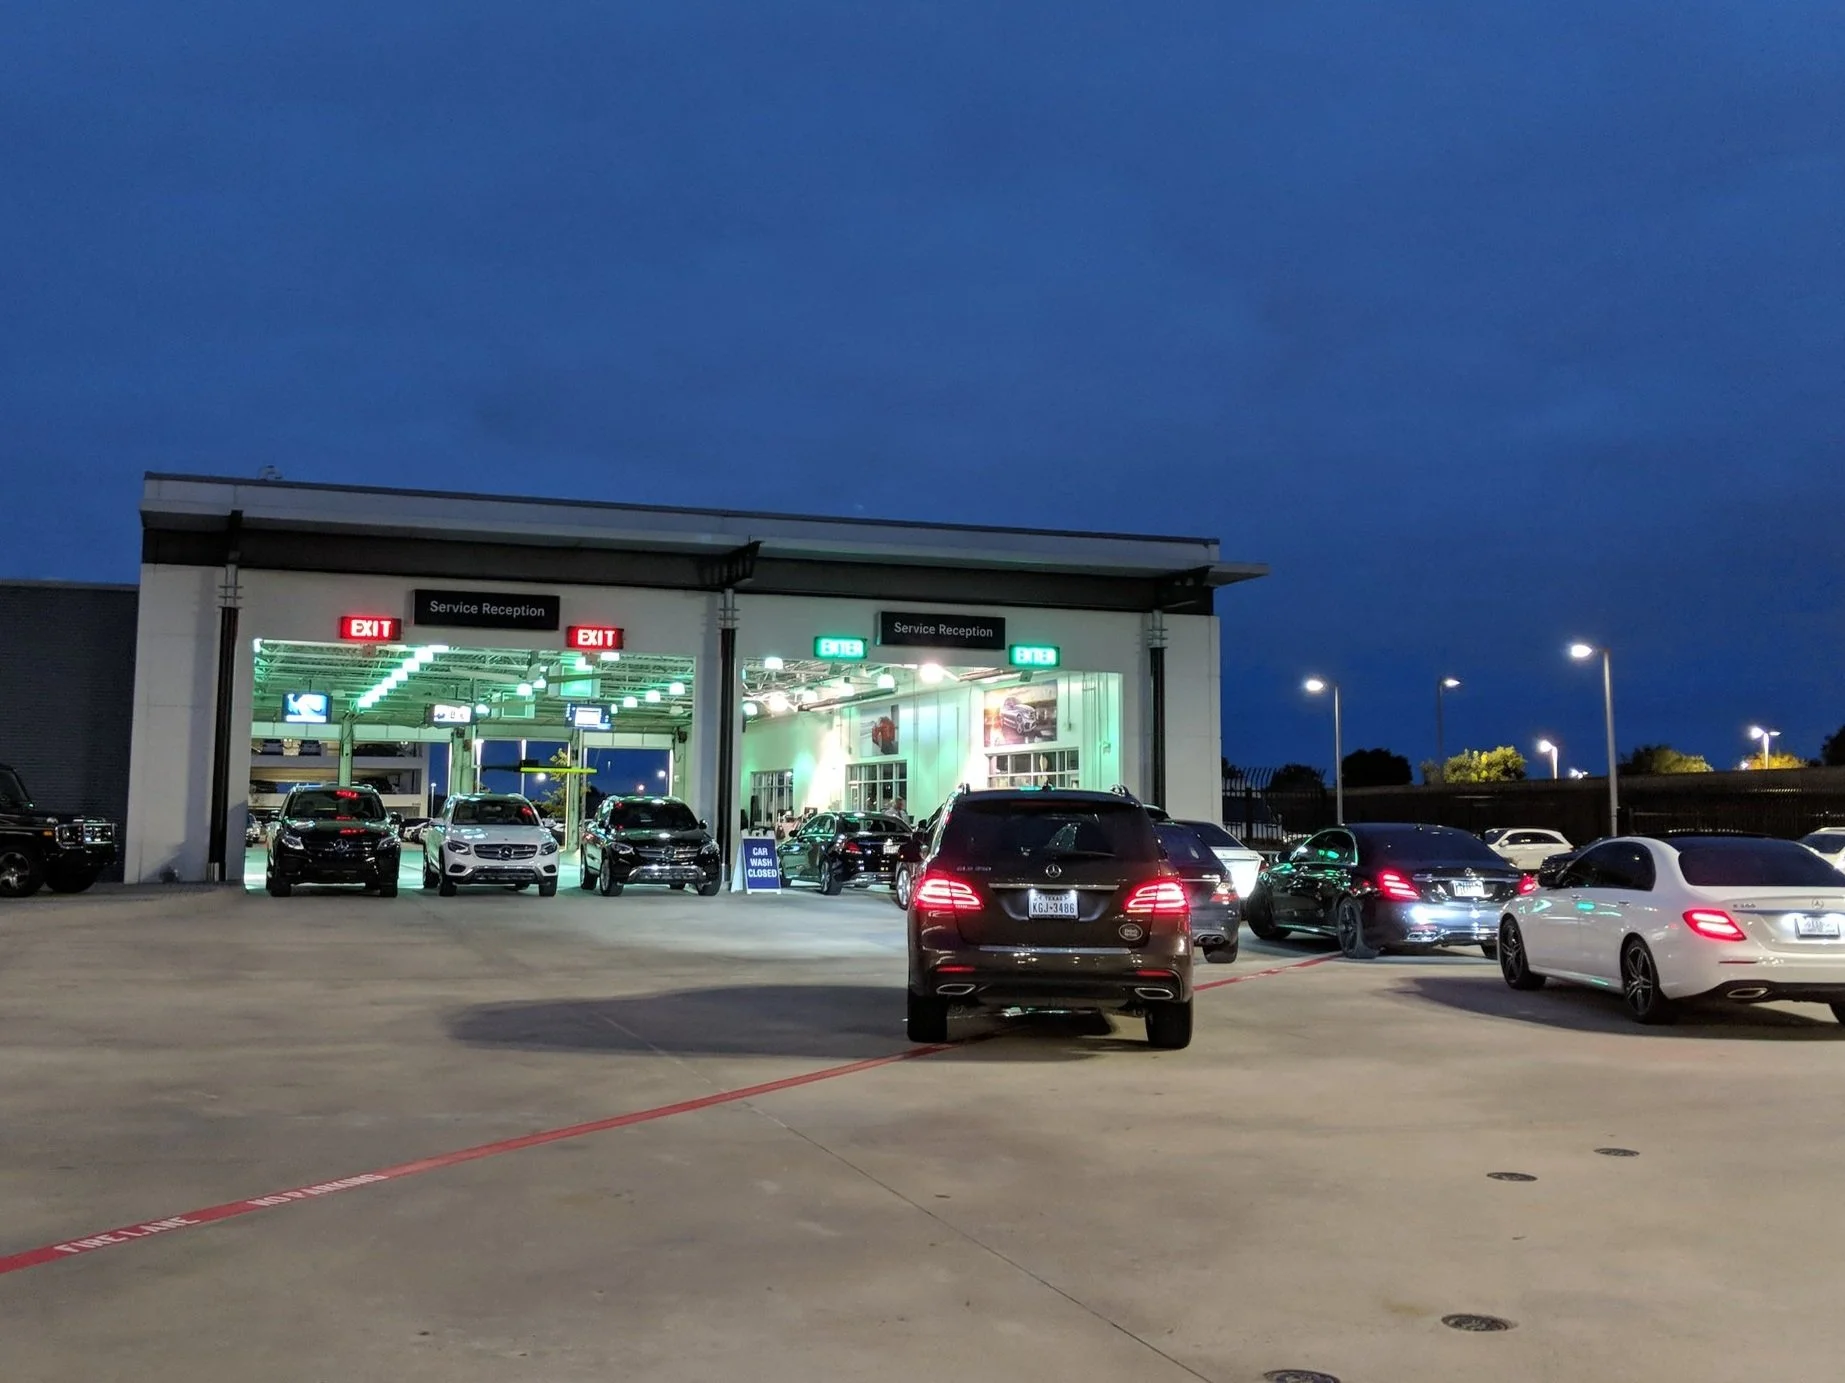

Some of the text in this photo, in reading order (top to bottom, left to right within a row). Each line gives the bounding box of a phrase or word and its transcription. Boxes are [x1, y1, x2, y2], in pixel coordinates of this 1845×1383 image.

[429, 600, 546, 618] Service Reception
[350, 619, 393, 638] EXIT
[893, 622, 994, 639] Service Reception
[577, 629, 616, 646] EXIT
[752, 847, 768, 856] CAR
[749, 858, 773, 867] WASH
[747, 868, 778, 878] CLOSED
[247, 1174, 389, 1207] NO PARKING
[53, 1216, 200, 1253] FIRE LANE
